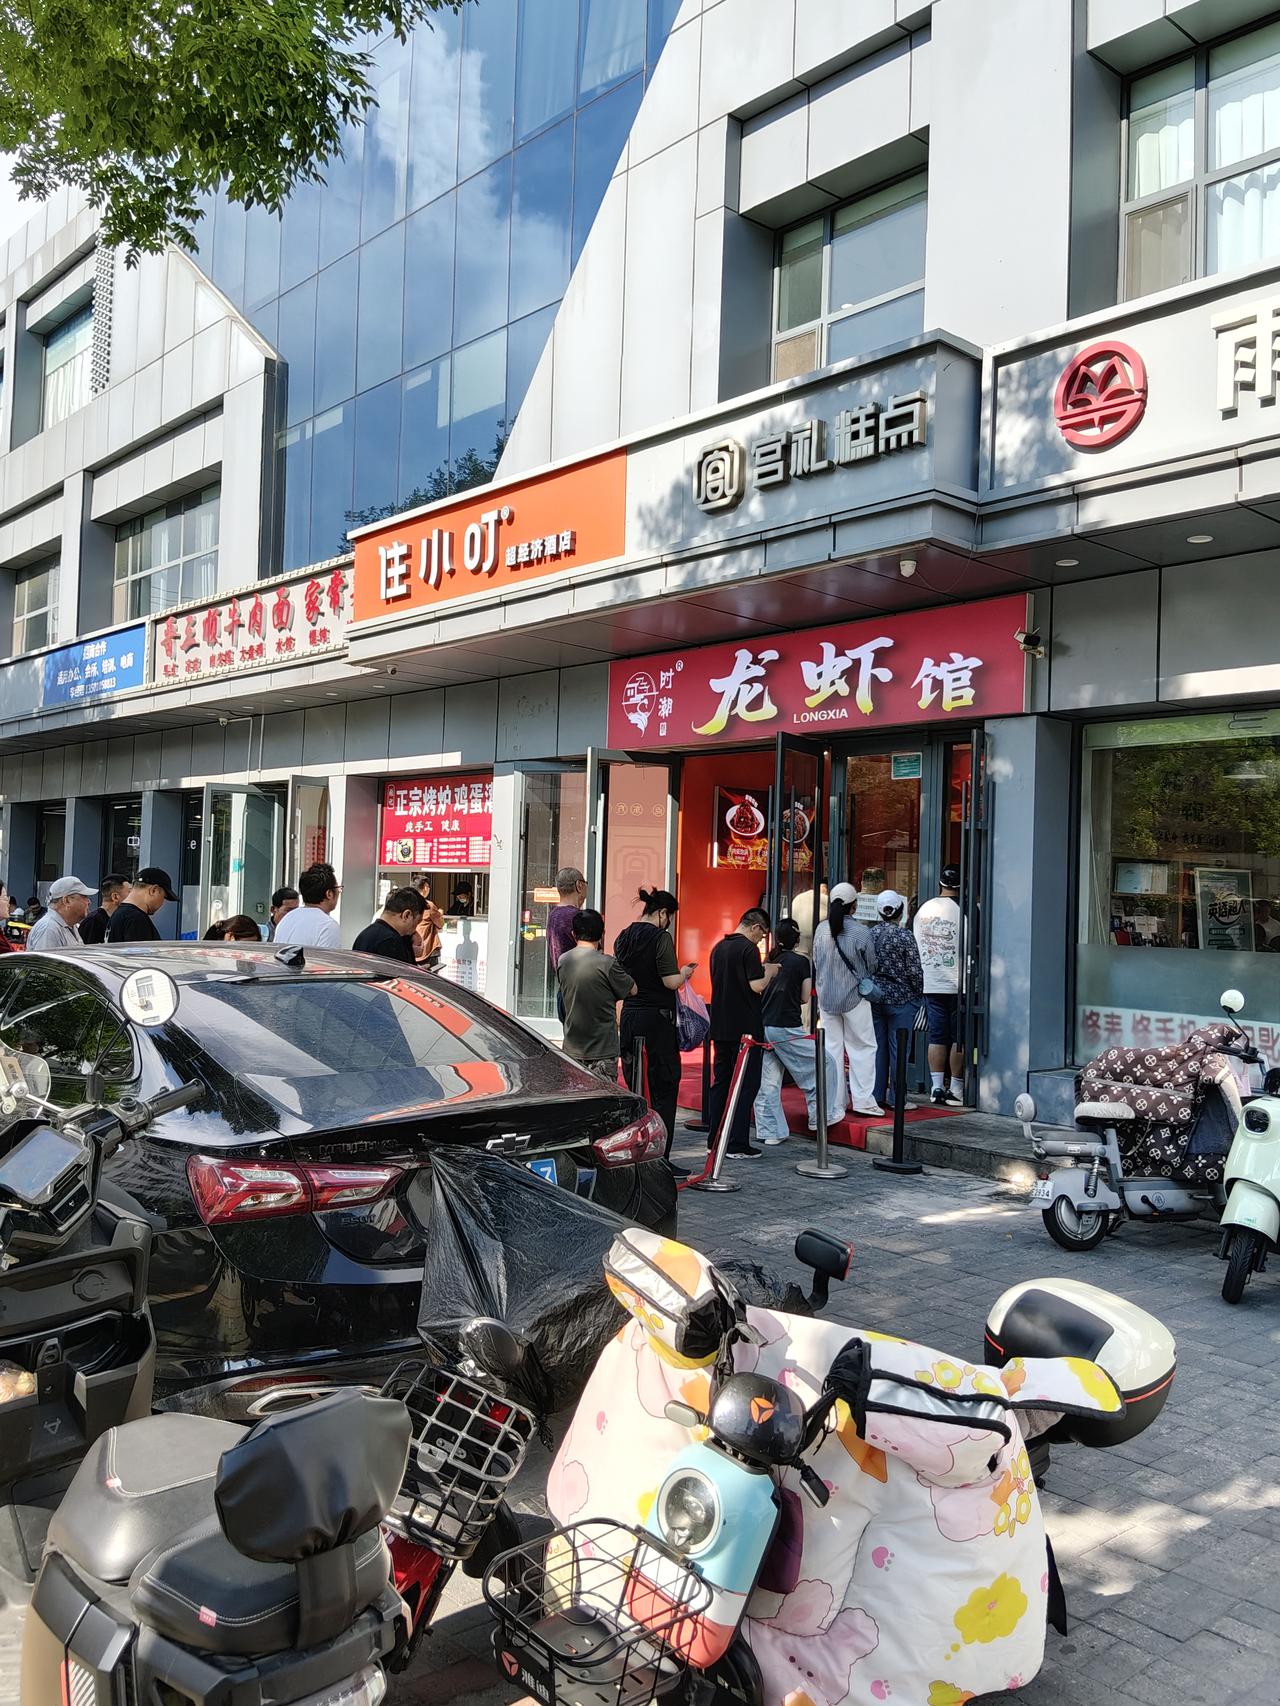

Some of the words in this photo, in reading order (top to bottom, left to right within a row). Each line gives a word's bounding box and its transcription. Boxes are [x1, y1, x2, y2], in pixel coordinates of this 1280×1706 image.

[751, 388, 928, 490] 宫礼糕点
[505, 530, 576, 569] 超经济酒店
[304, 568, 354, 626] 家常
[658, 668, 676, 719] 时潮
[691, 637, 984, 737] 龙虾馆
[793, 709, 849, 724] LONGXIA
[441, 819, 461, 832] 健康
